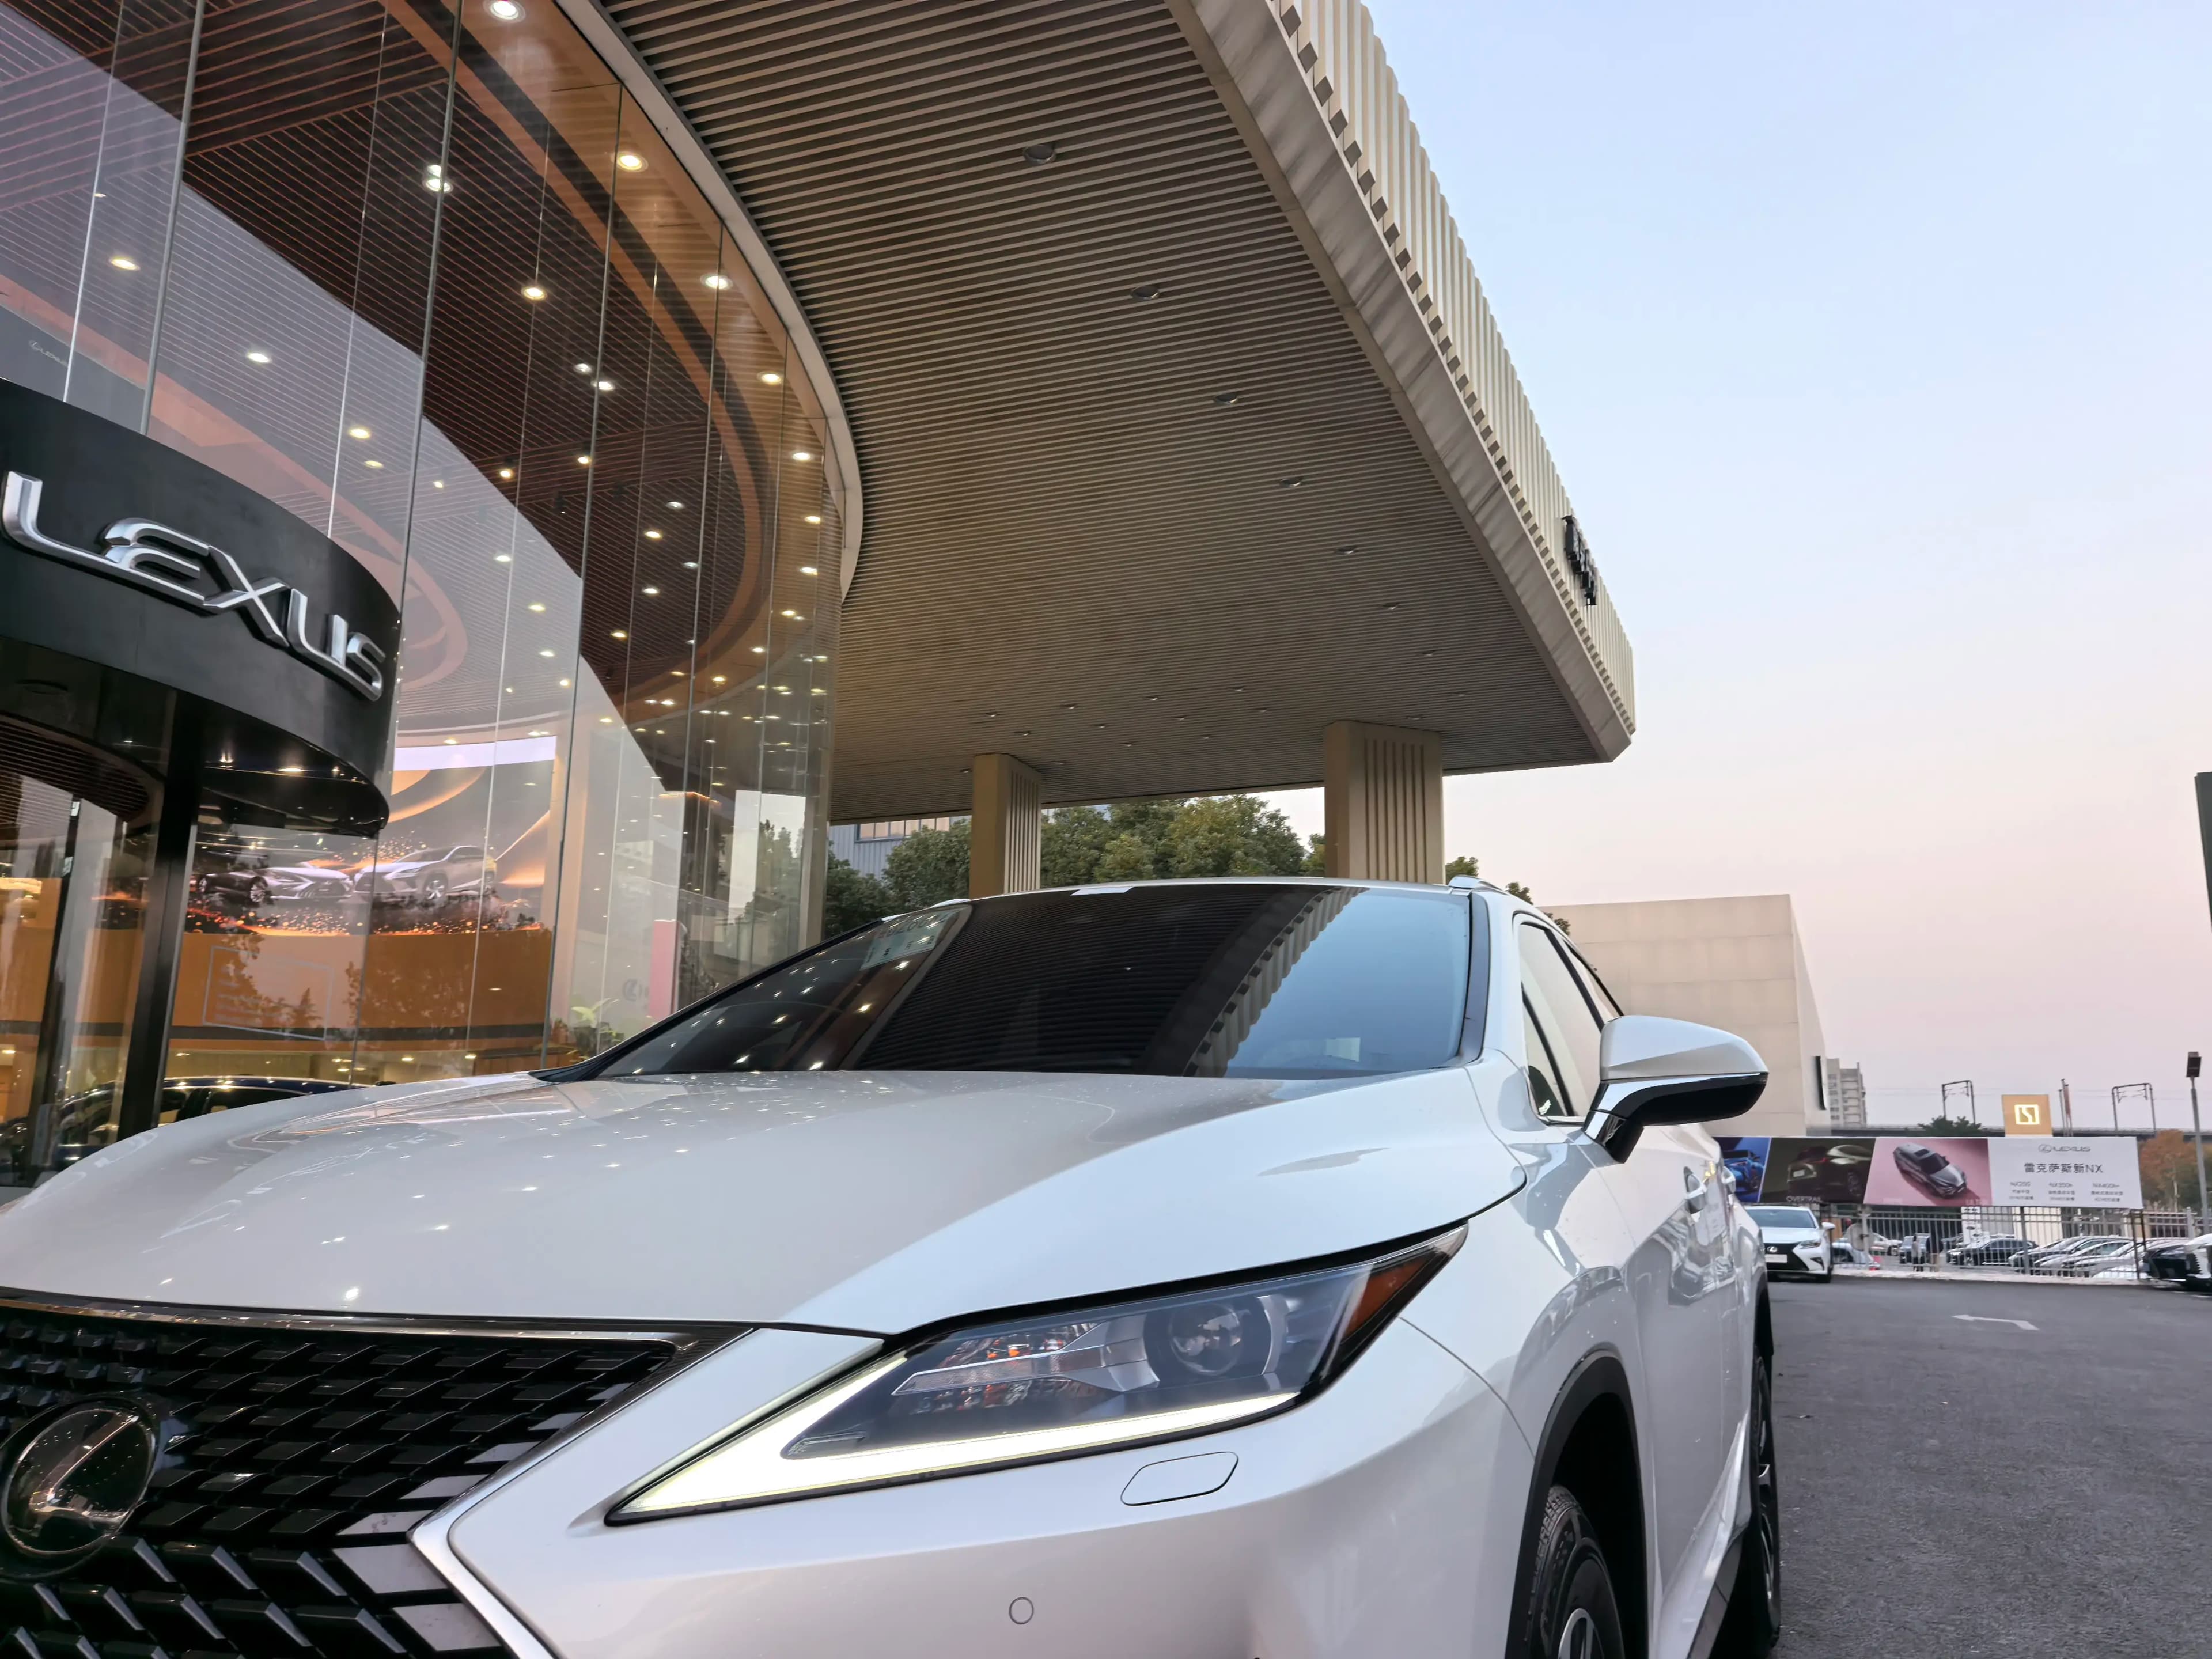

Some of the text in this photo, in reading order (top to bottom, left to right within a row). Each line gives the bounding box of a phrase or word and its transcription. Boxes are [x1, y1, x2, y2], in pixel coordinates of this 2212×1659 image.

[2, 471, 386, 702] LEXUS
[2024, 1162, 2103, 1173] 雷克萨斯新NX
